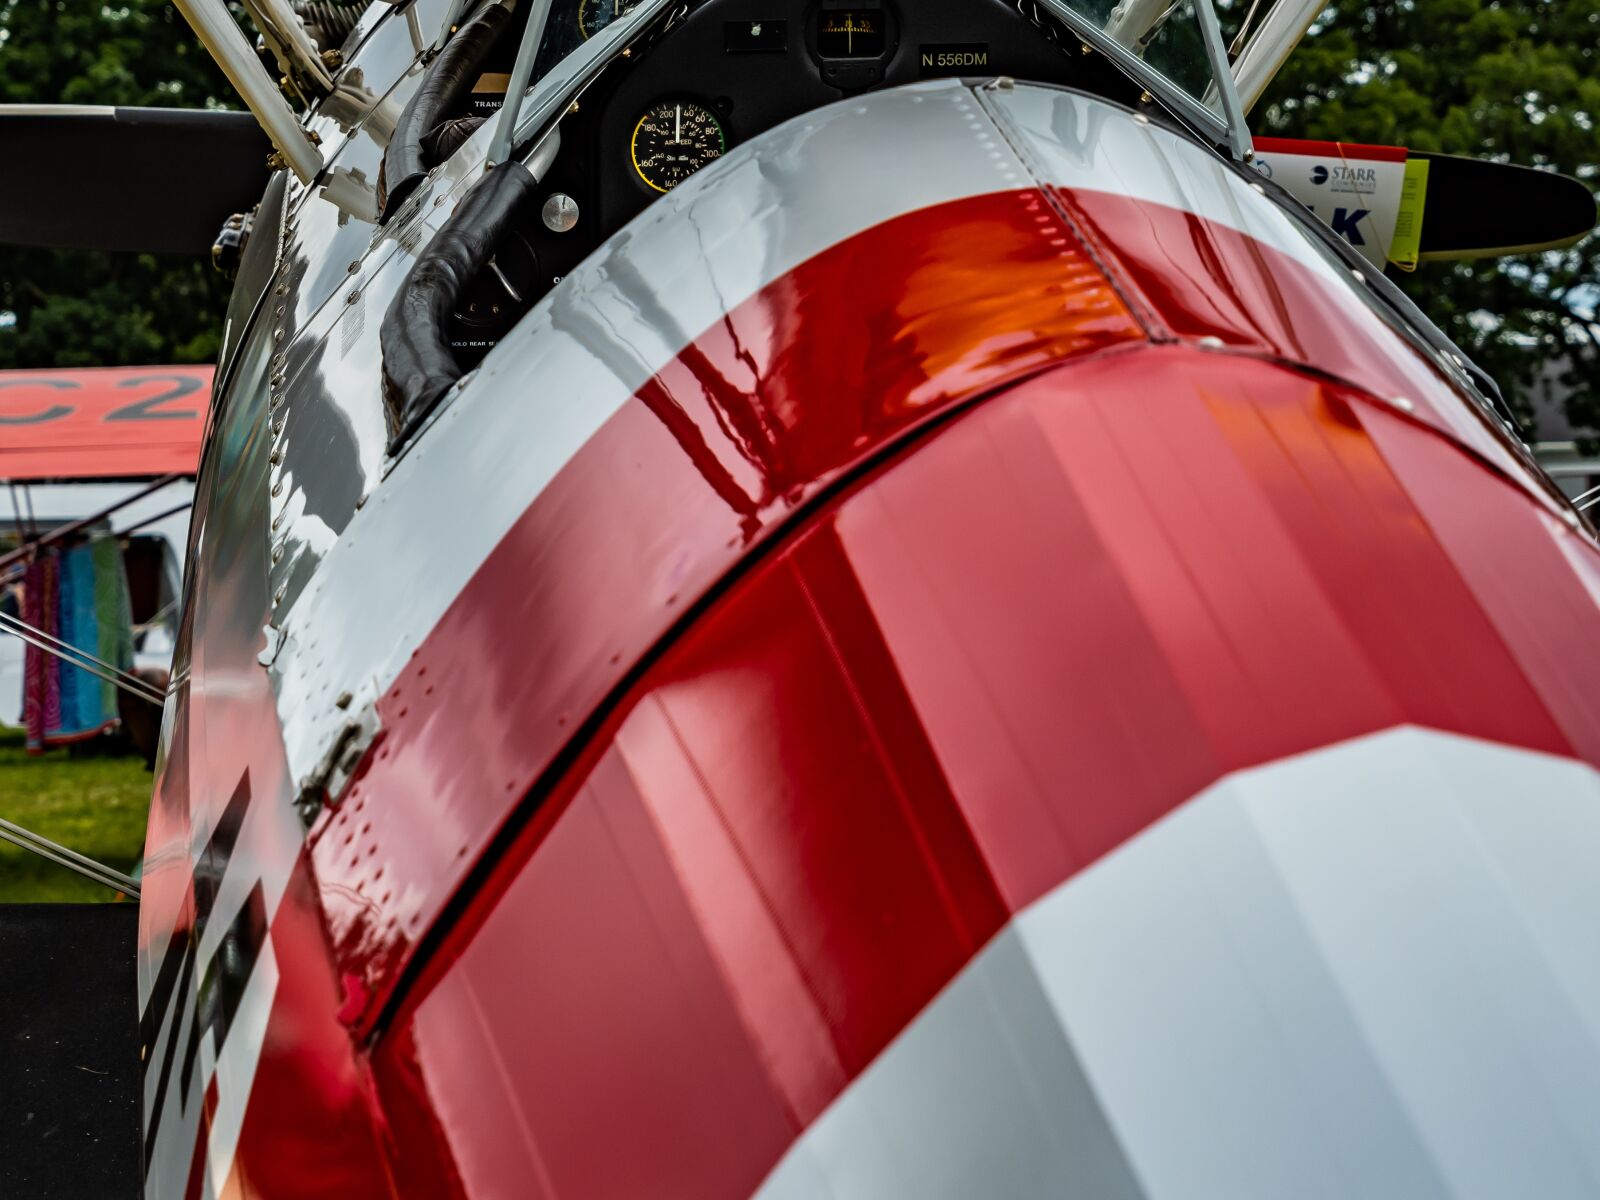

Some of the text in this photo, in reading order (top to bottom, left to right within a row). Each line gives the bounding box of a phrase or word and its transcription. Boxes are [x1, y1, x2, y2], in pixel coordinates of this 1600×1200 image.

[922, 52, 987, 66] N 556DM
[474, 100, 504, 108] TRANS
[659, 110, 674, 119] 200
[683, 109, 694, 117] 40
[695, 114, 706, 122] 60
[644, 123, 657, 132] 180
[705, 127, 715, 135] 80
[705, 149, 719, 157] 100
[641, 159, 654, 167] 160
[1331, 166, 1376, 182] STARR
[664, 180, 678, 188] 140
